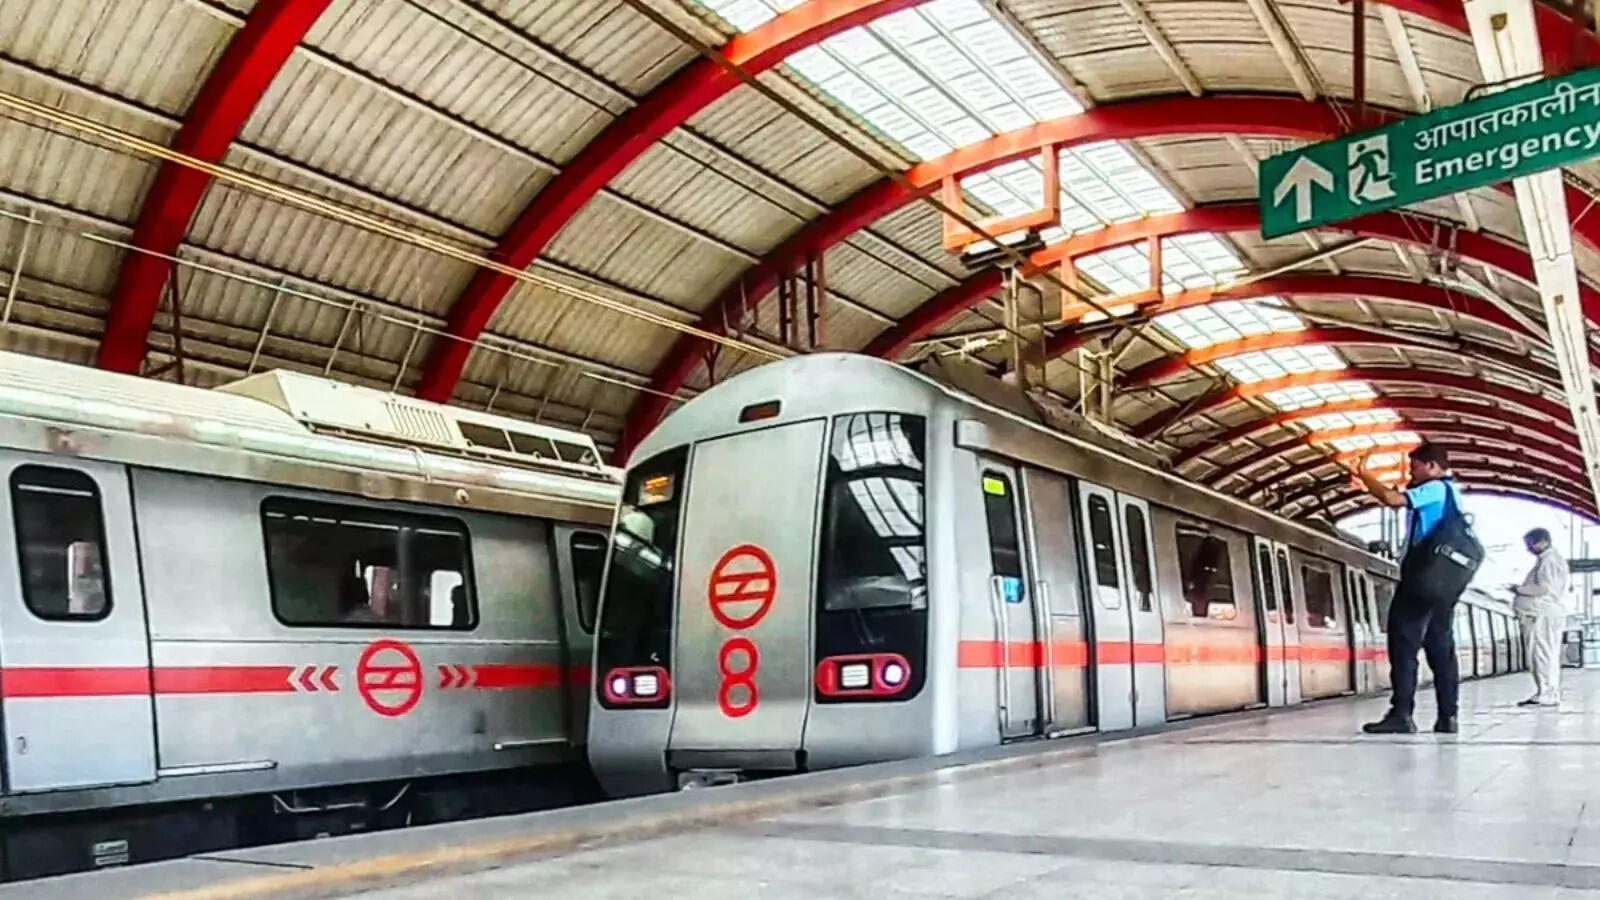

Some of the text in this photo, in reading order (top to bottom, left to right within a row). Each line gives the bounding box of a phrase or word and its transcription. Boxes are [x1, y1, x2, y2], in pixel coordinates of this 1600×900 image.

[1413, 82, 1600, 151] आपातकालीन
[1415, 122, 1600, 185] Emergency
[718, 637, 759, 718] 8
